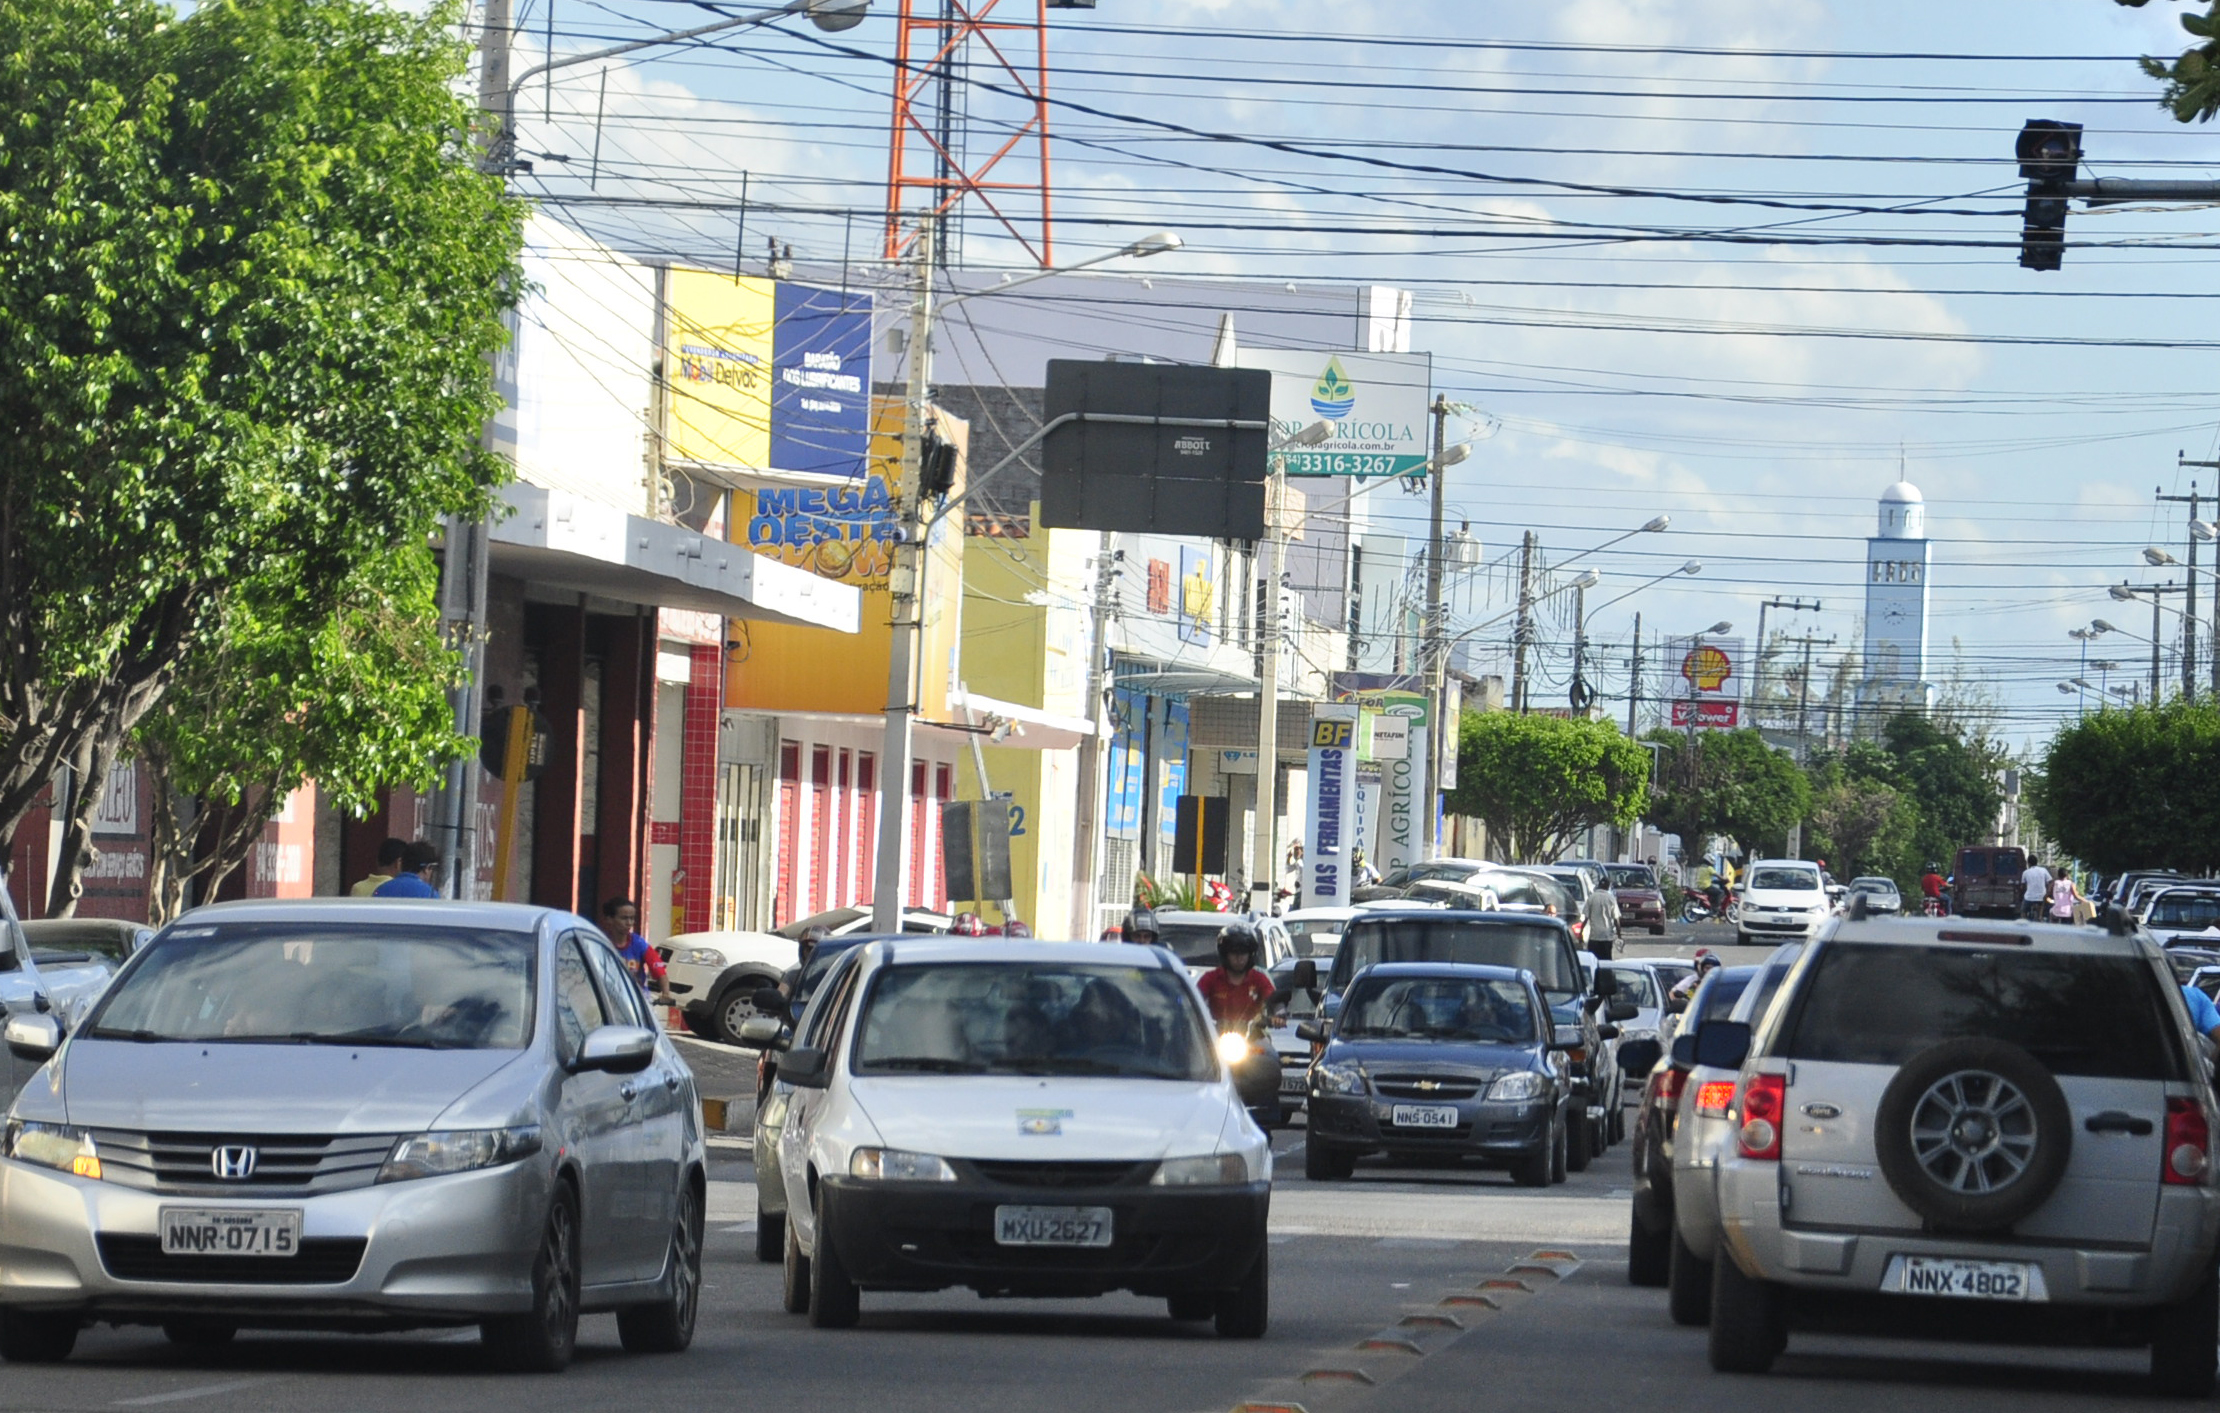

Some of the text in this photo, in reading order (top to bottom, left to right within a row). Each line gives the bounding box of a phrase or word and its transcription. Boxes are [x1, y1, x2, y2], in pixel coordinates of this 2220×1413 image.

[680, 357, 713, 382] Mobil
[716, 361, 758, 389] Delvac
[1301, 454, 1396, 474] 3316-3267
[757, 476, 890, 518] MEGA
[748, 509, 898, 548] OESTE
[1316, 722, 1351, 747] BF
[1374, 731, 1405, 739] NETAFIM
[1314, 748, 1343, 897] DAS FERRAMENTAS
